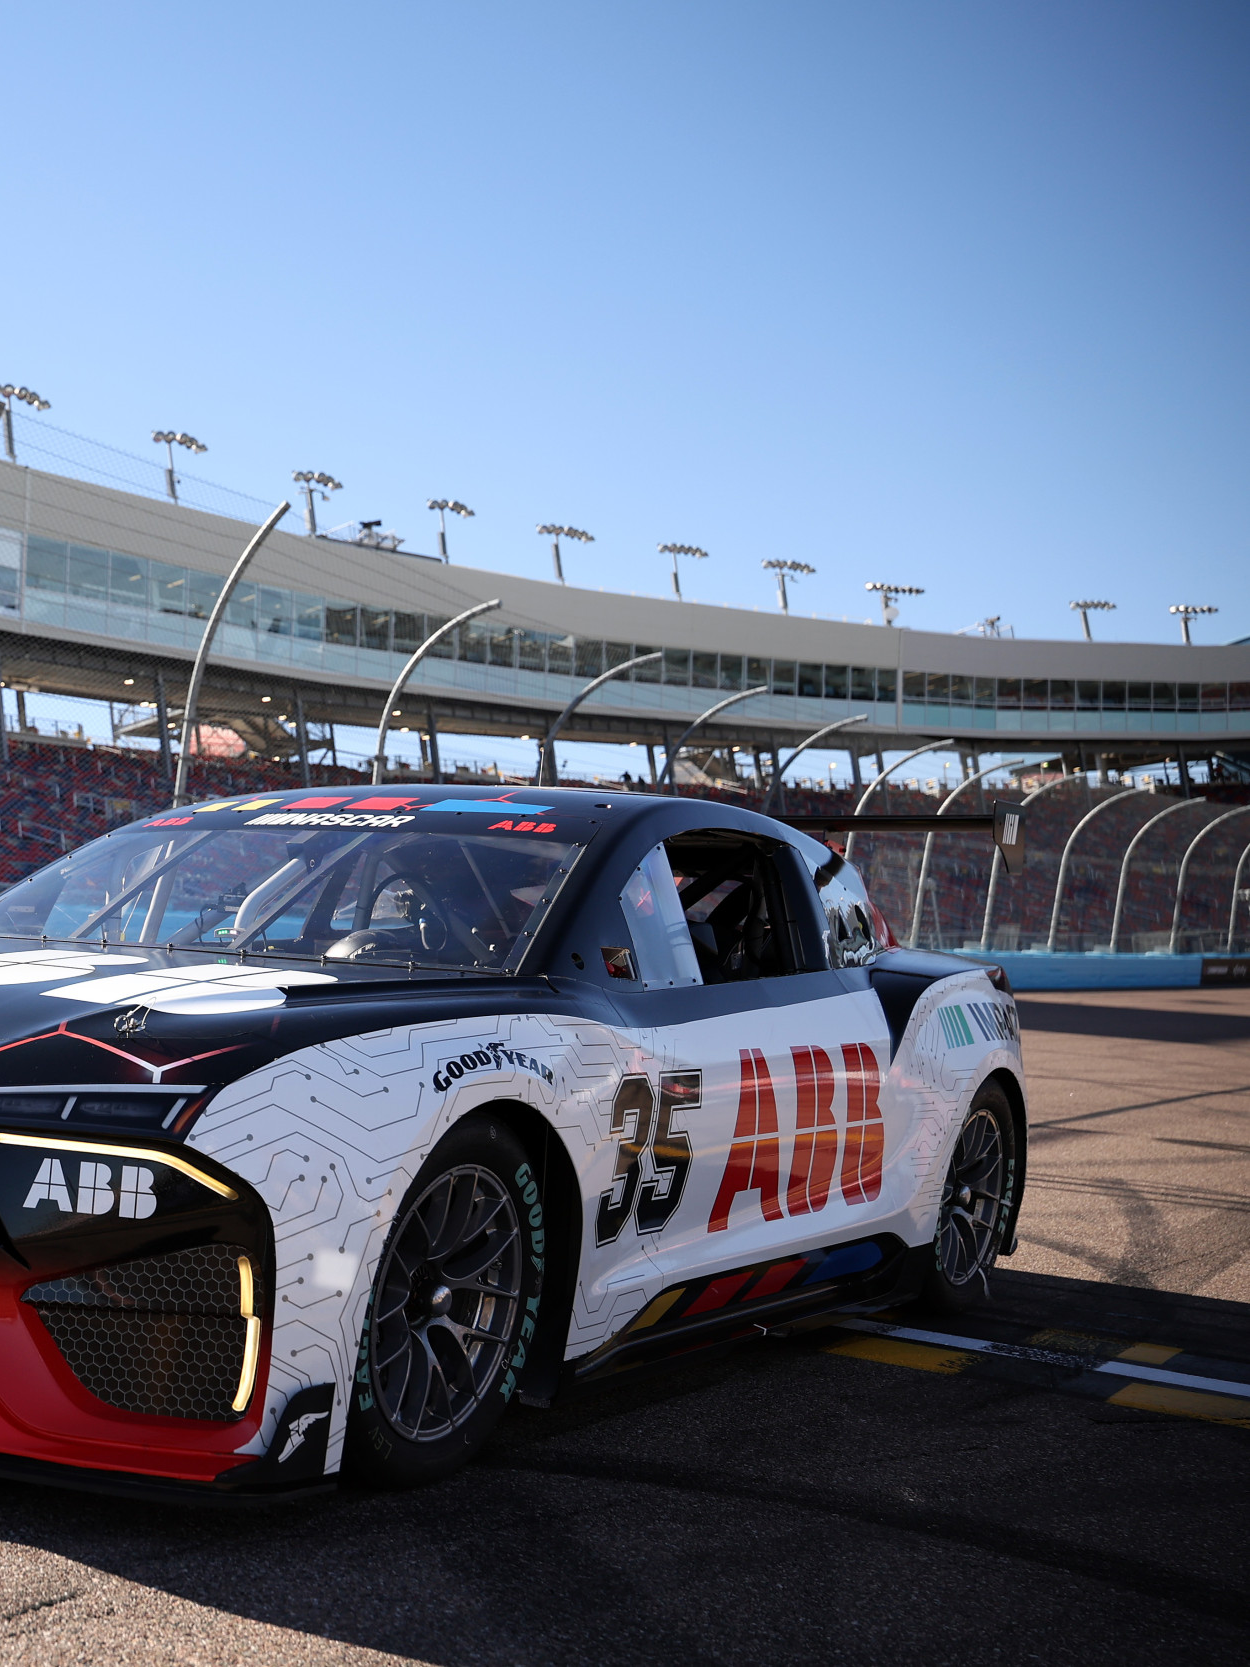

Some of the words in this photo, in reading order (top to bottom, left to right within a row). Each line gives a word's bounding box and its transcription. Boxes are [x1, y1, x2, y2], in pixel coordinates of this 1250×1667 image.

[141, 816, 194, 828] ABB
[277, 813, 416, 828] NASCAR
[487, 819, 557, 834] ABB
[432, 1046, 554, 1092] GOODYEAR
[595, 1068, 702, 1250] 35
[707, 1042, 885, 1234] ABB
[22, 1158, 158, 1220] ABB
[997, 1158, 1016, 1236] EAGLE
[499, 1162, 546, 1404] GOODYEAR
